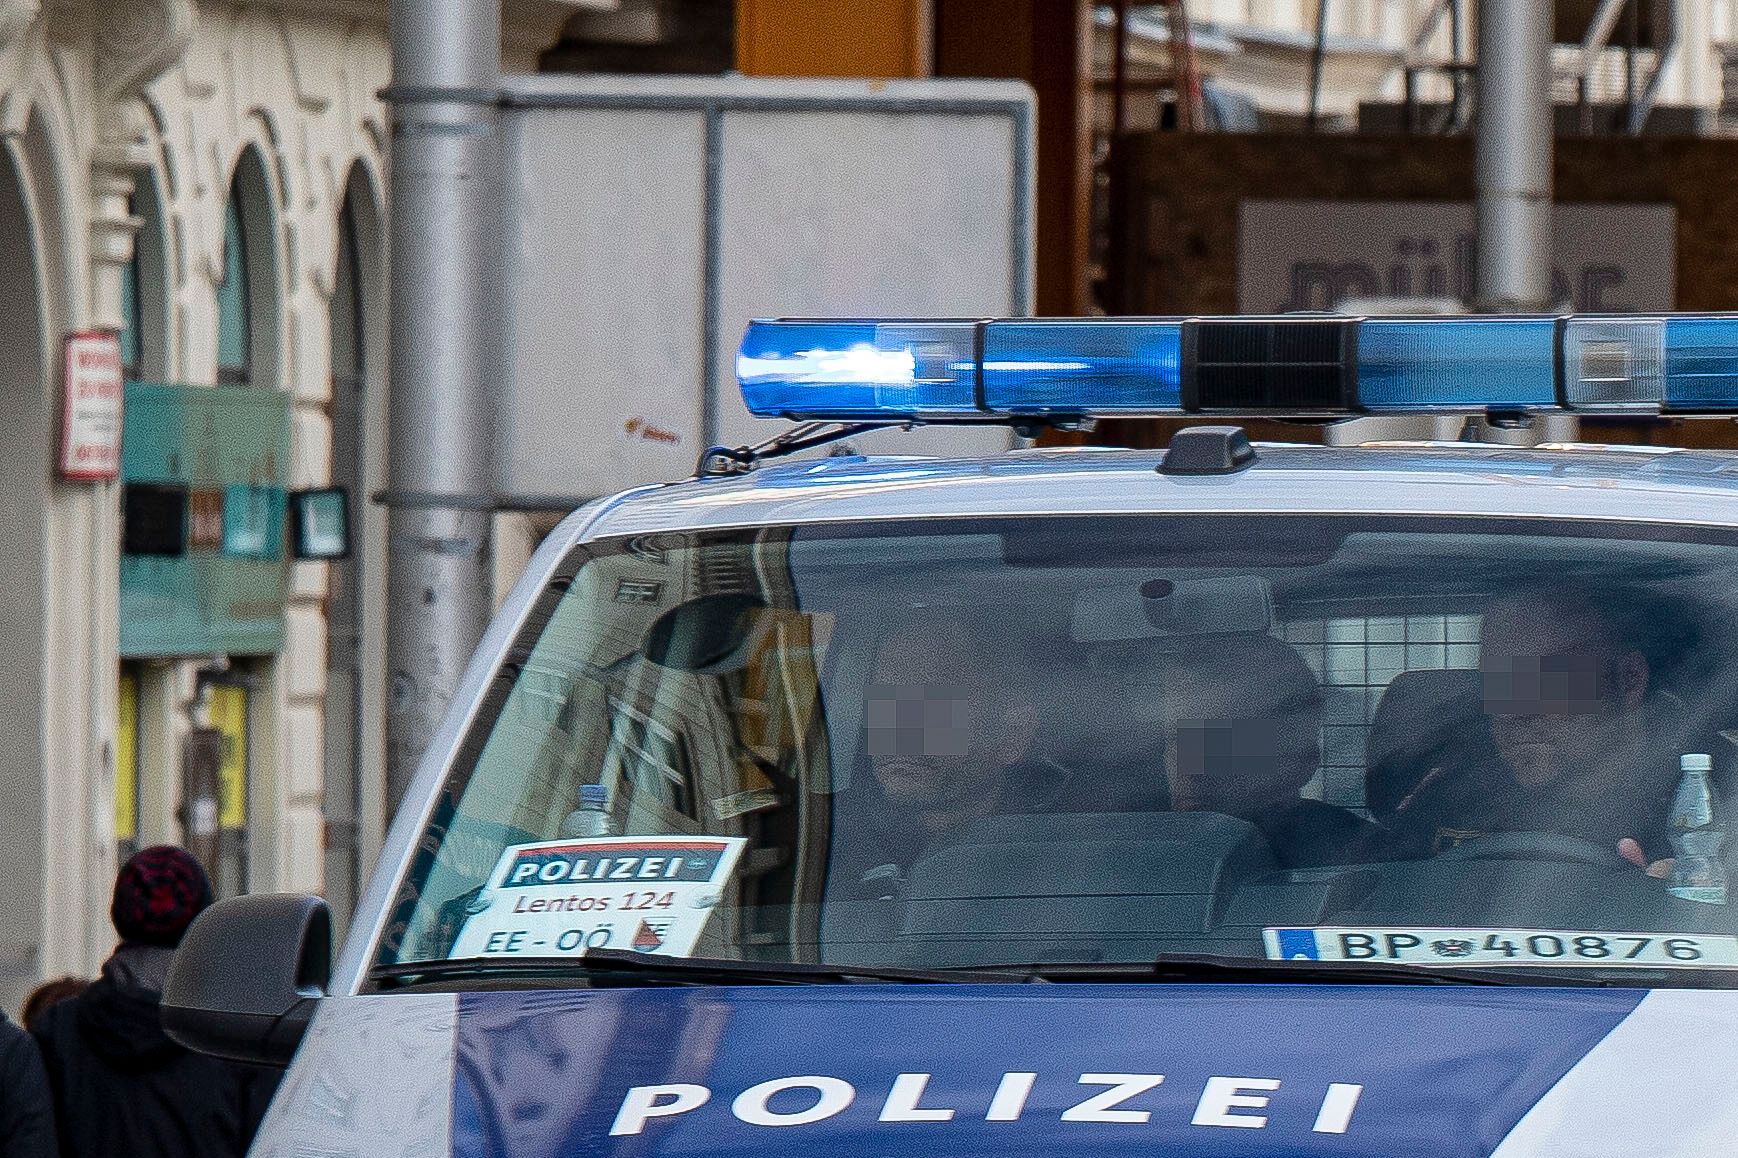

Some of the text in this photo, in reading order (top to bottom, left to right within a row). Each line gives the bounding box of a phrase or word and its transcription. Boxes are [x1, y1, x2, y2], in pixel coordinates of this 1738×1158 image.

[510, 857, 684, 883] POLIZEI
[512, 891, 676, 913] Lentos 124
[484, 931, 528, 952] EE
[1338, 932, 1701, 961] BP 40876
[608, 1072, 1364, 1136] POLIZEI
